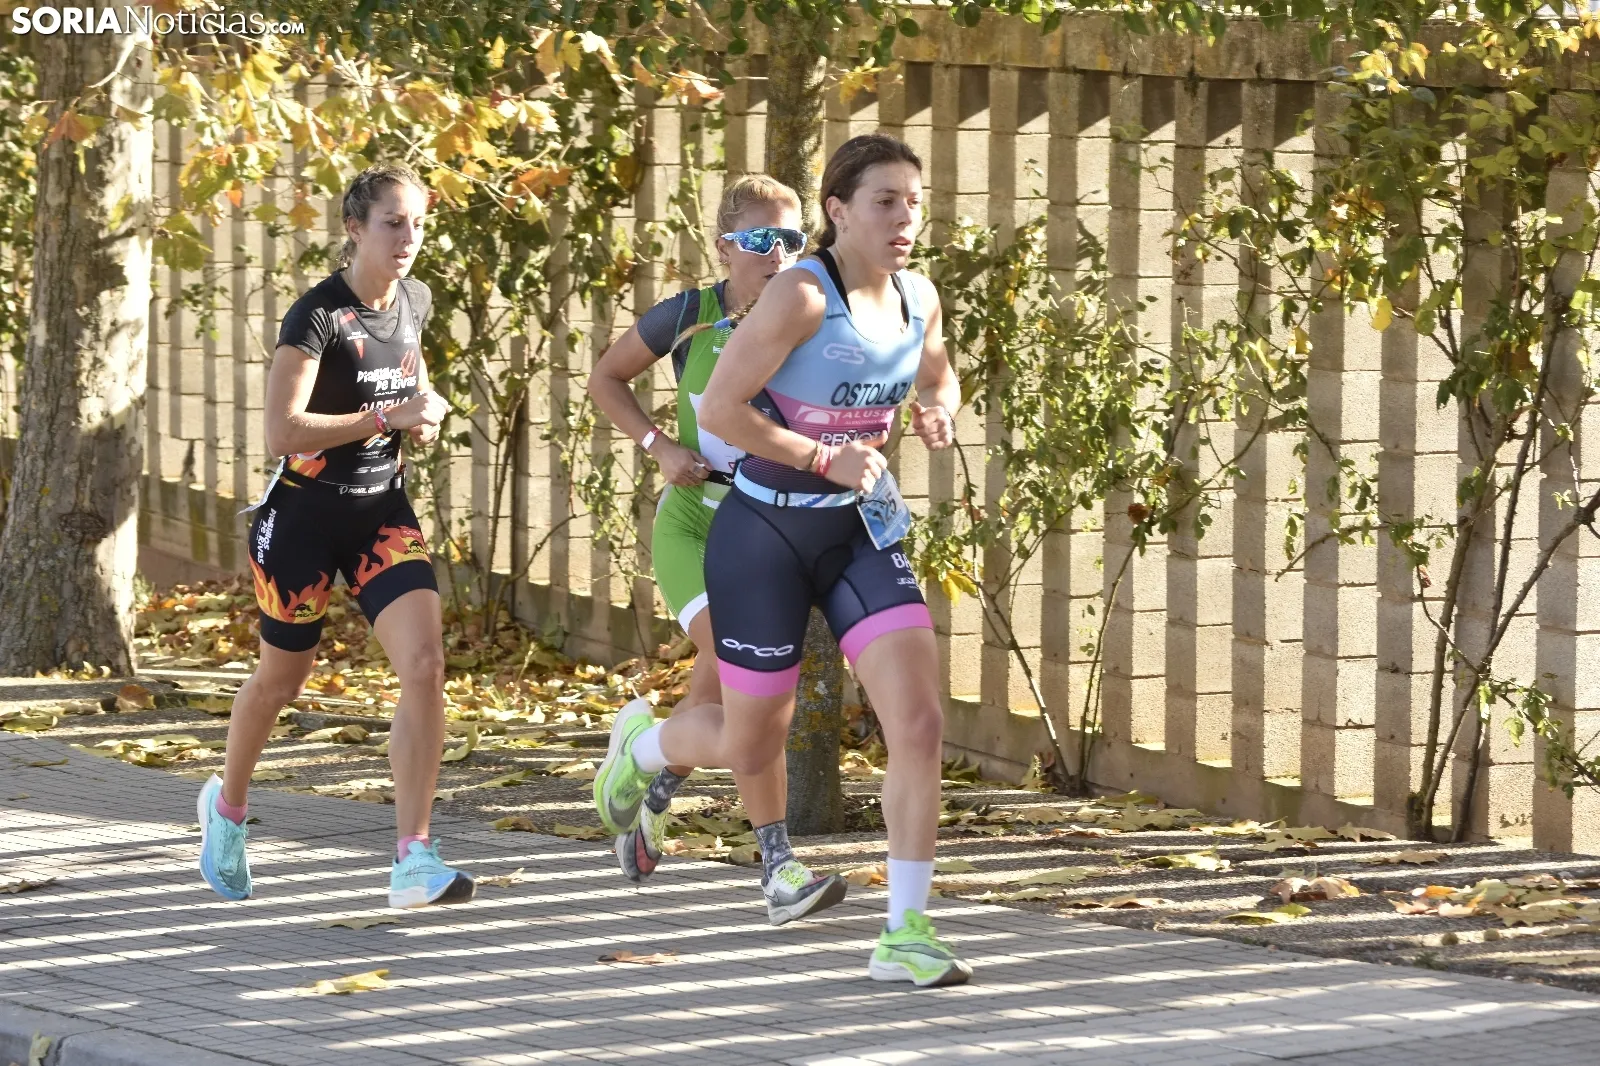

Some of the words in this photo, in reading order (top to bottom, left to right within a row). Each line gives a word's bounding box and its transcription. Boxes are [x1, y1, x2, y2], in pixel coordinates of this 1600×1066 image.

[842, 409, 888, 419] ALUSI
[819, 429, 881, 447] PEÑOT
[721, 638, 794, 657] orca
